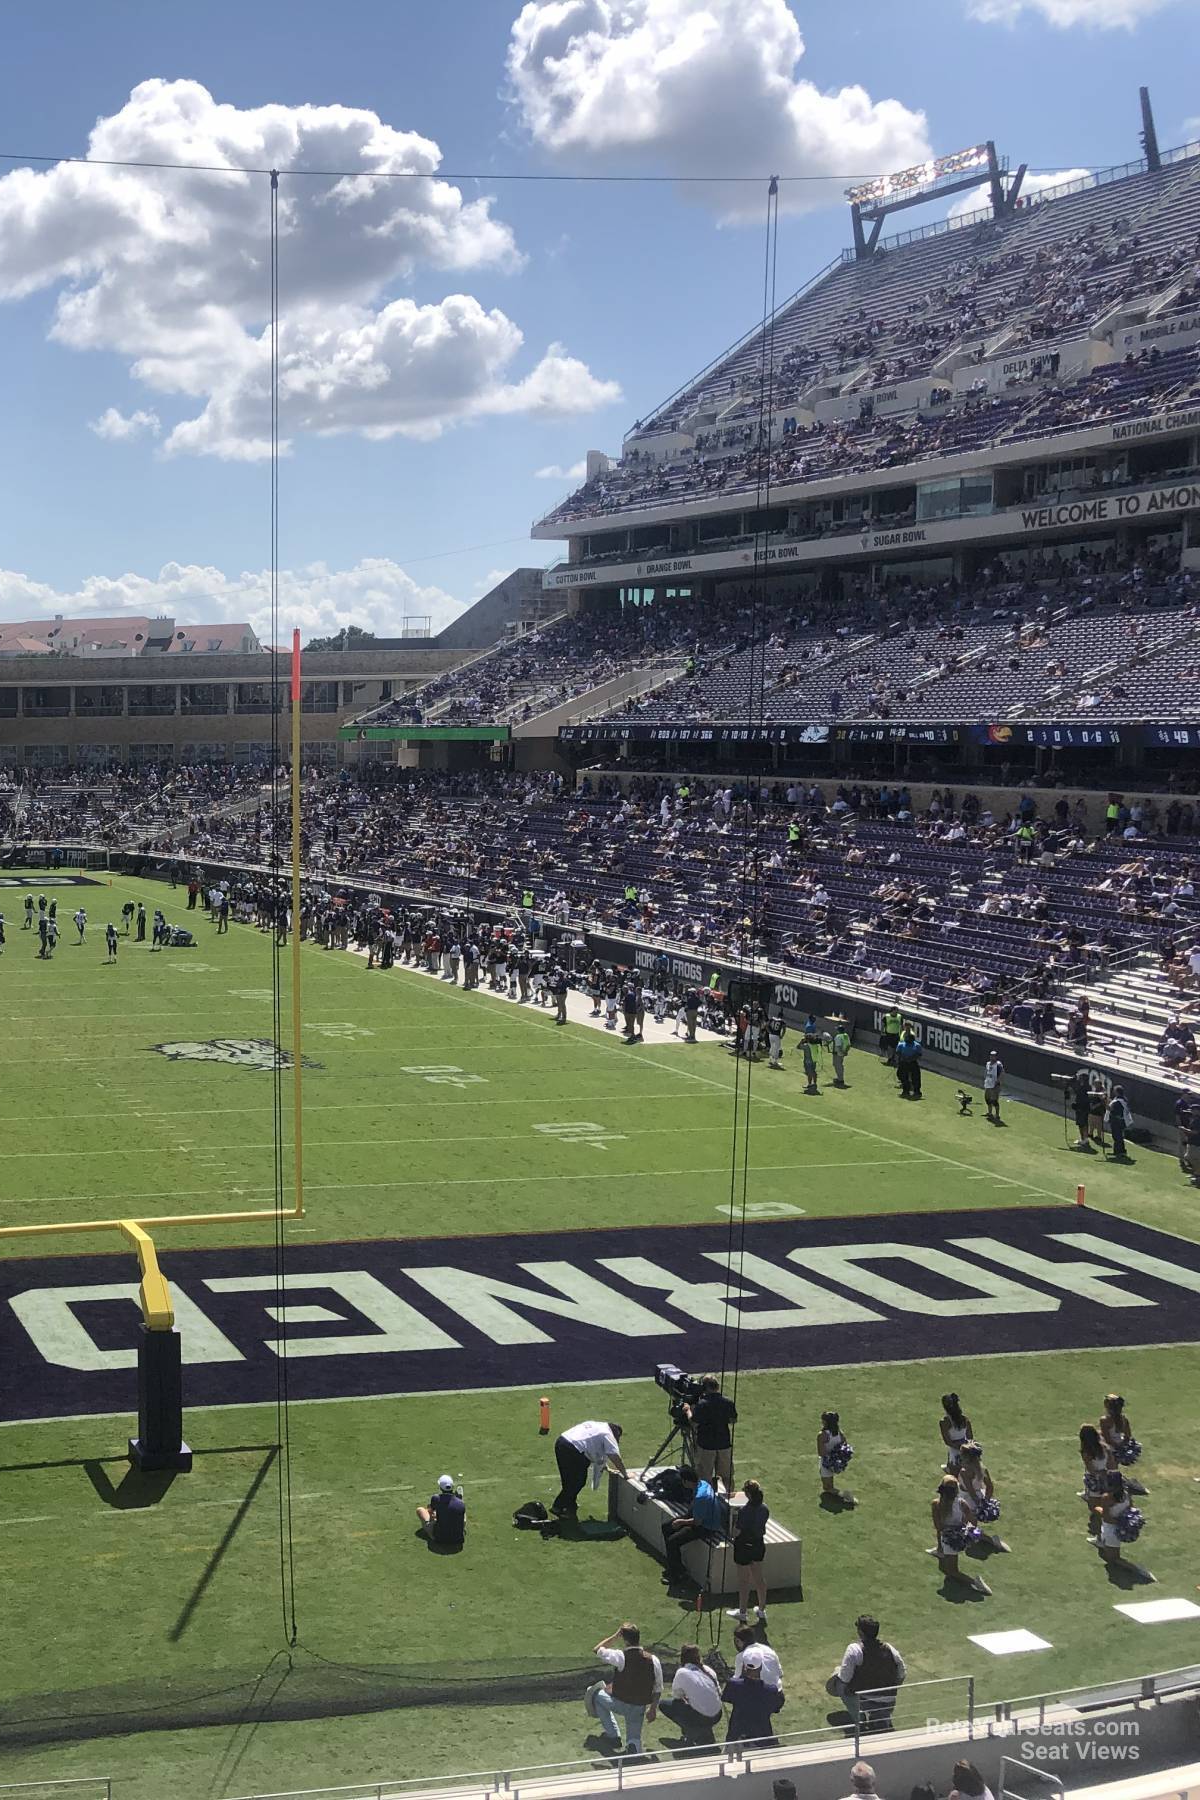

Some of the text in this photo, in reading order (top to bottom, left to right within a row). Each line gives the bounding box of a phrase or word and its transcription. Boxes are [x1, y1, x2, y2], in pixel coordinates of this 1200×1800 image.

[1004, 360, 1028, 374] DELTA
[877, 390, 898, 402] BOWL
[1113, 420, 1163, 440] NATIONAL
[1022, 499, 1108, 529] WELCOME
[1116, 494, 1140, 516] TO
[873, 529, 926, 547] SUGAR BOWL
[754, 547, 799, 562] FIESTA BOWL
[646, 560, 692, 574] ORANGE BOWL
[556, 571, 597, 584] COTTON BOWL
[925, 730, 934, 740] 40
[1027, 731, 1033, 741] 2
[1054, 731, 1060, 742] 0
[1174, 731, 1188, 743] 49
[672, 959, 703, 981] FROGS
[775, 984, 798, 1006] TCU
[927, 1026, 970, 1056] FROGS
[402, 1065, 489, 1083] 20
[532, 1121, 629, 1144] 10
[8, 1233, 1200, 1372] HORNED
